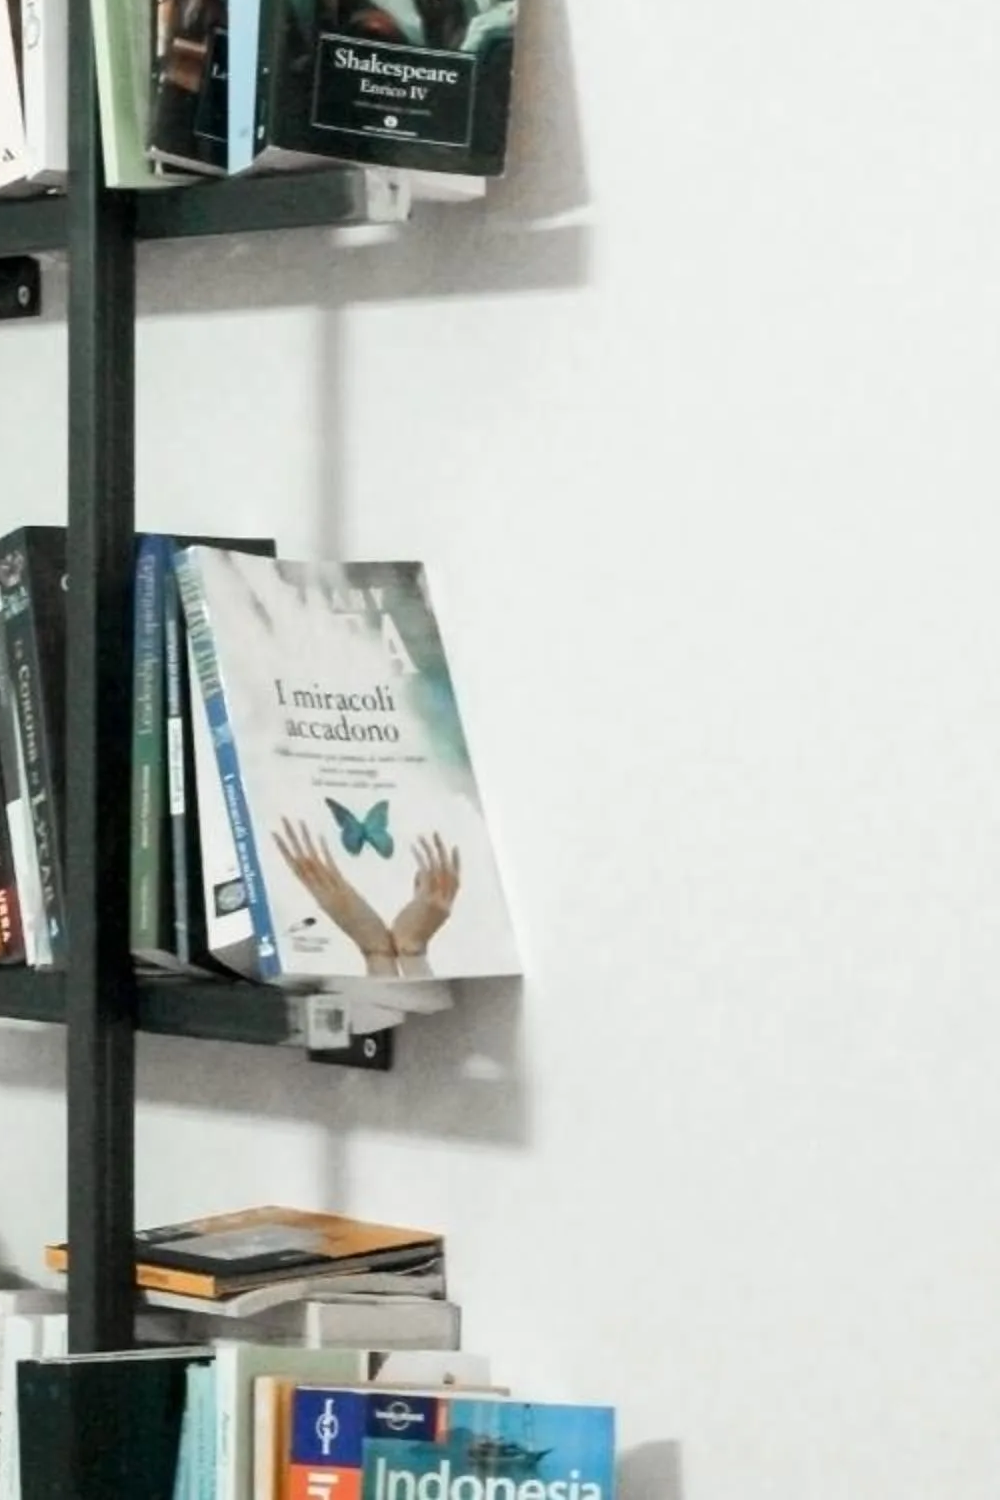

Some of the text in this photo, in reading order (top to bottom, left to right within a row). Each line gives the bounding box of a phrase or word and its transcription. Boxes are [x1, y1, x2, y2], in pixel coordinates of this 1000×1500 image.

[334, 47, 458, 85] Shakespeare
[360, 77, 429, 102] Enrico IV
[275, 680, 395, 713] I miracoli
[286, 714, 400, 743] accadono
[376, 1457, 602, 1500] Indonesia
